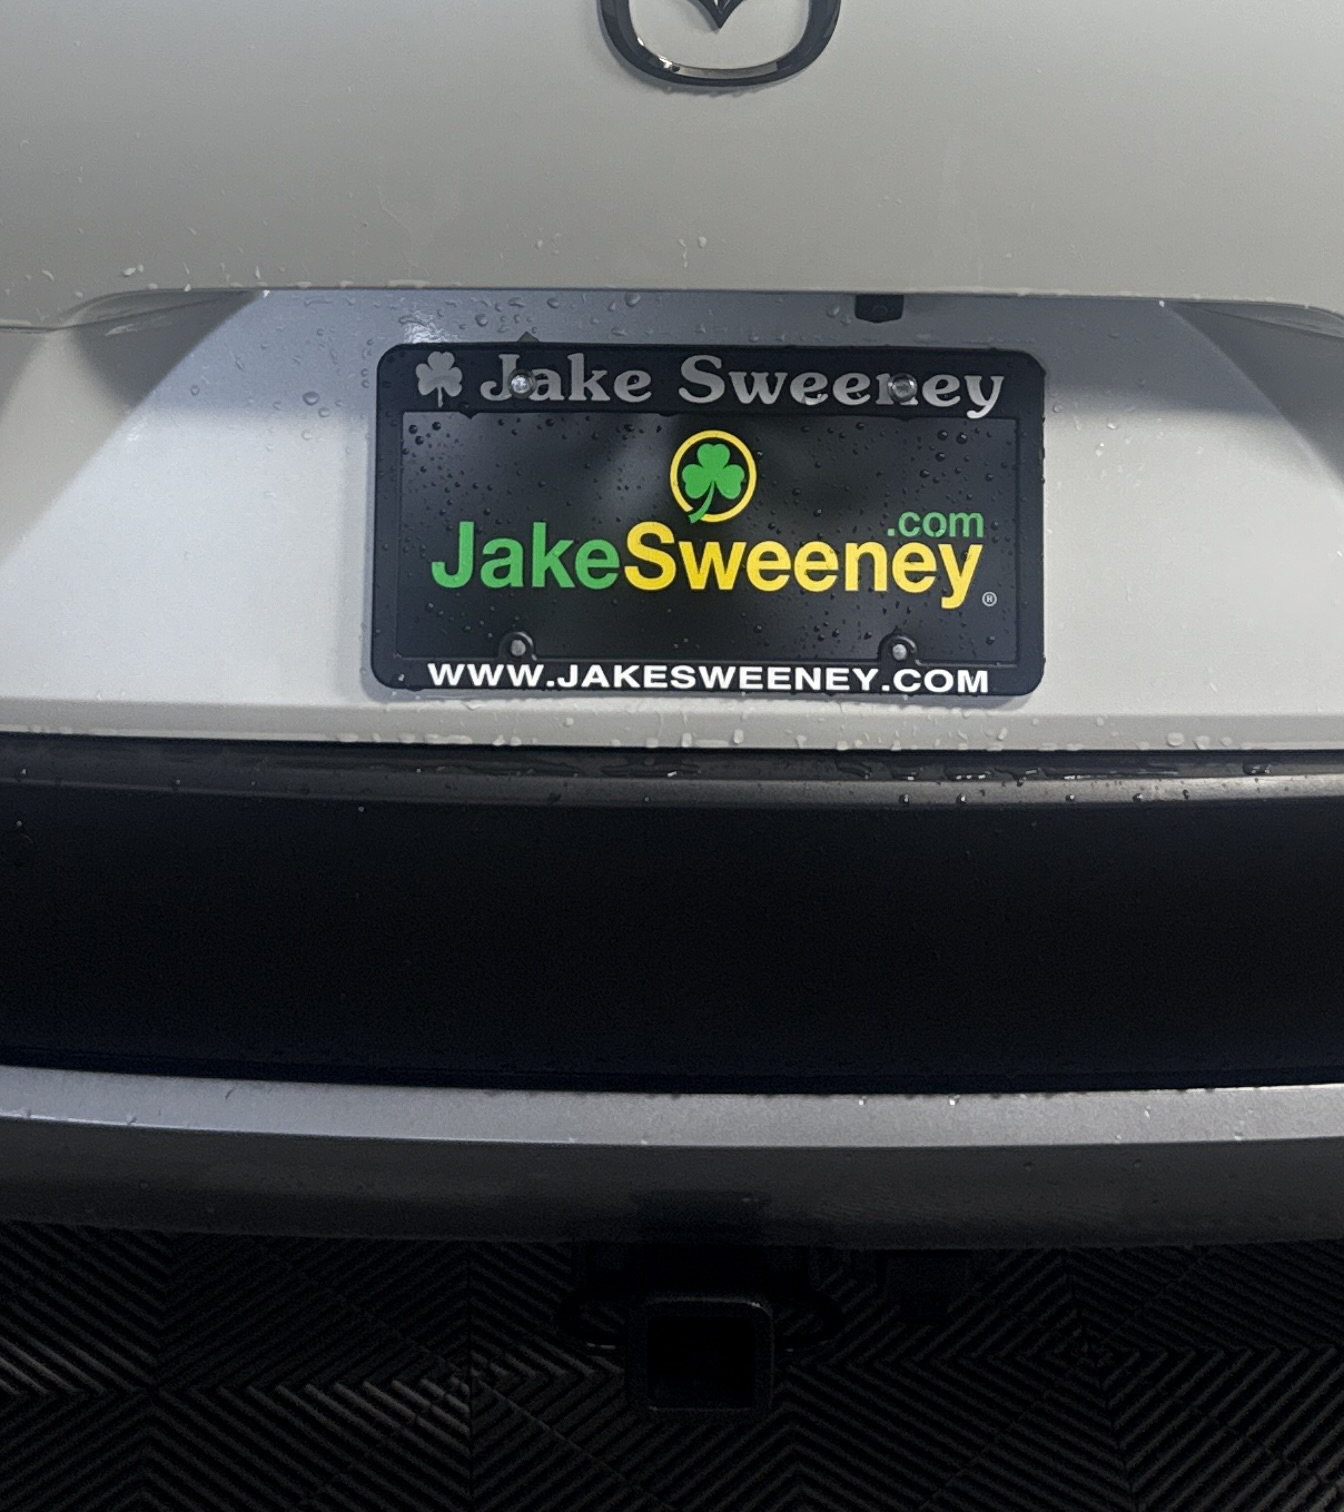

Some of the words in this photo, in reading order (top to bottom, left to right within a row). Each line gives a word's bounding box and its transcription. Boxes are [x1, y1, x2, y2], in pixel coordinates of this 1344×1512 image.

[480, 353, 652, 402] Jake
[887, 511, 984, 539] .com
[427, 663, 989, 694] WWW.JAKESWEENEY.COM
